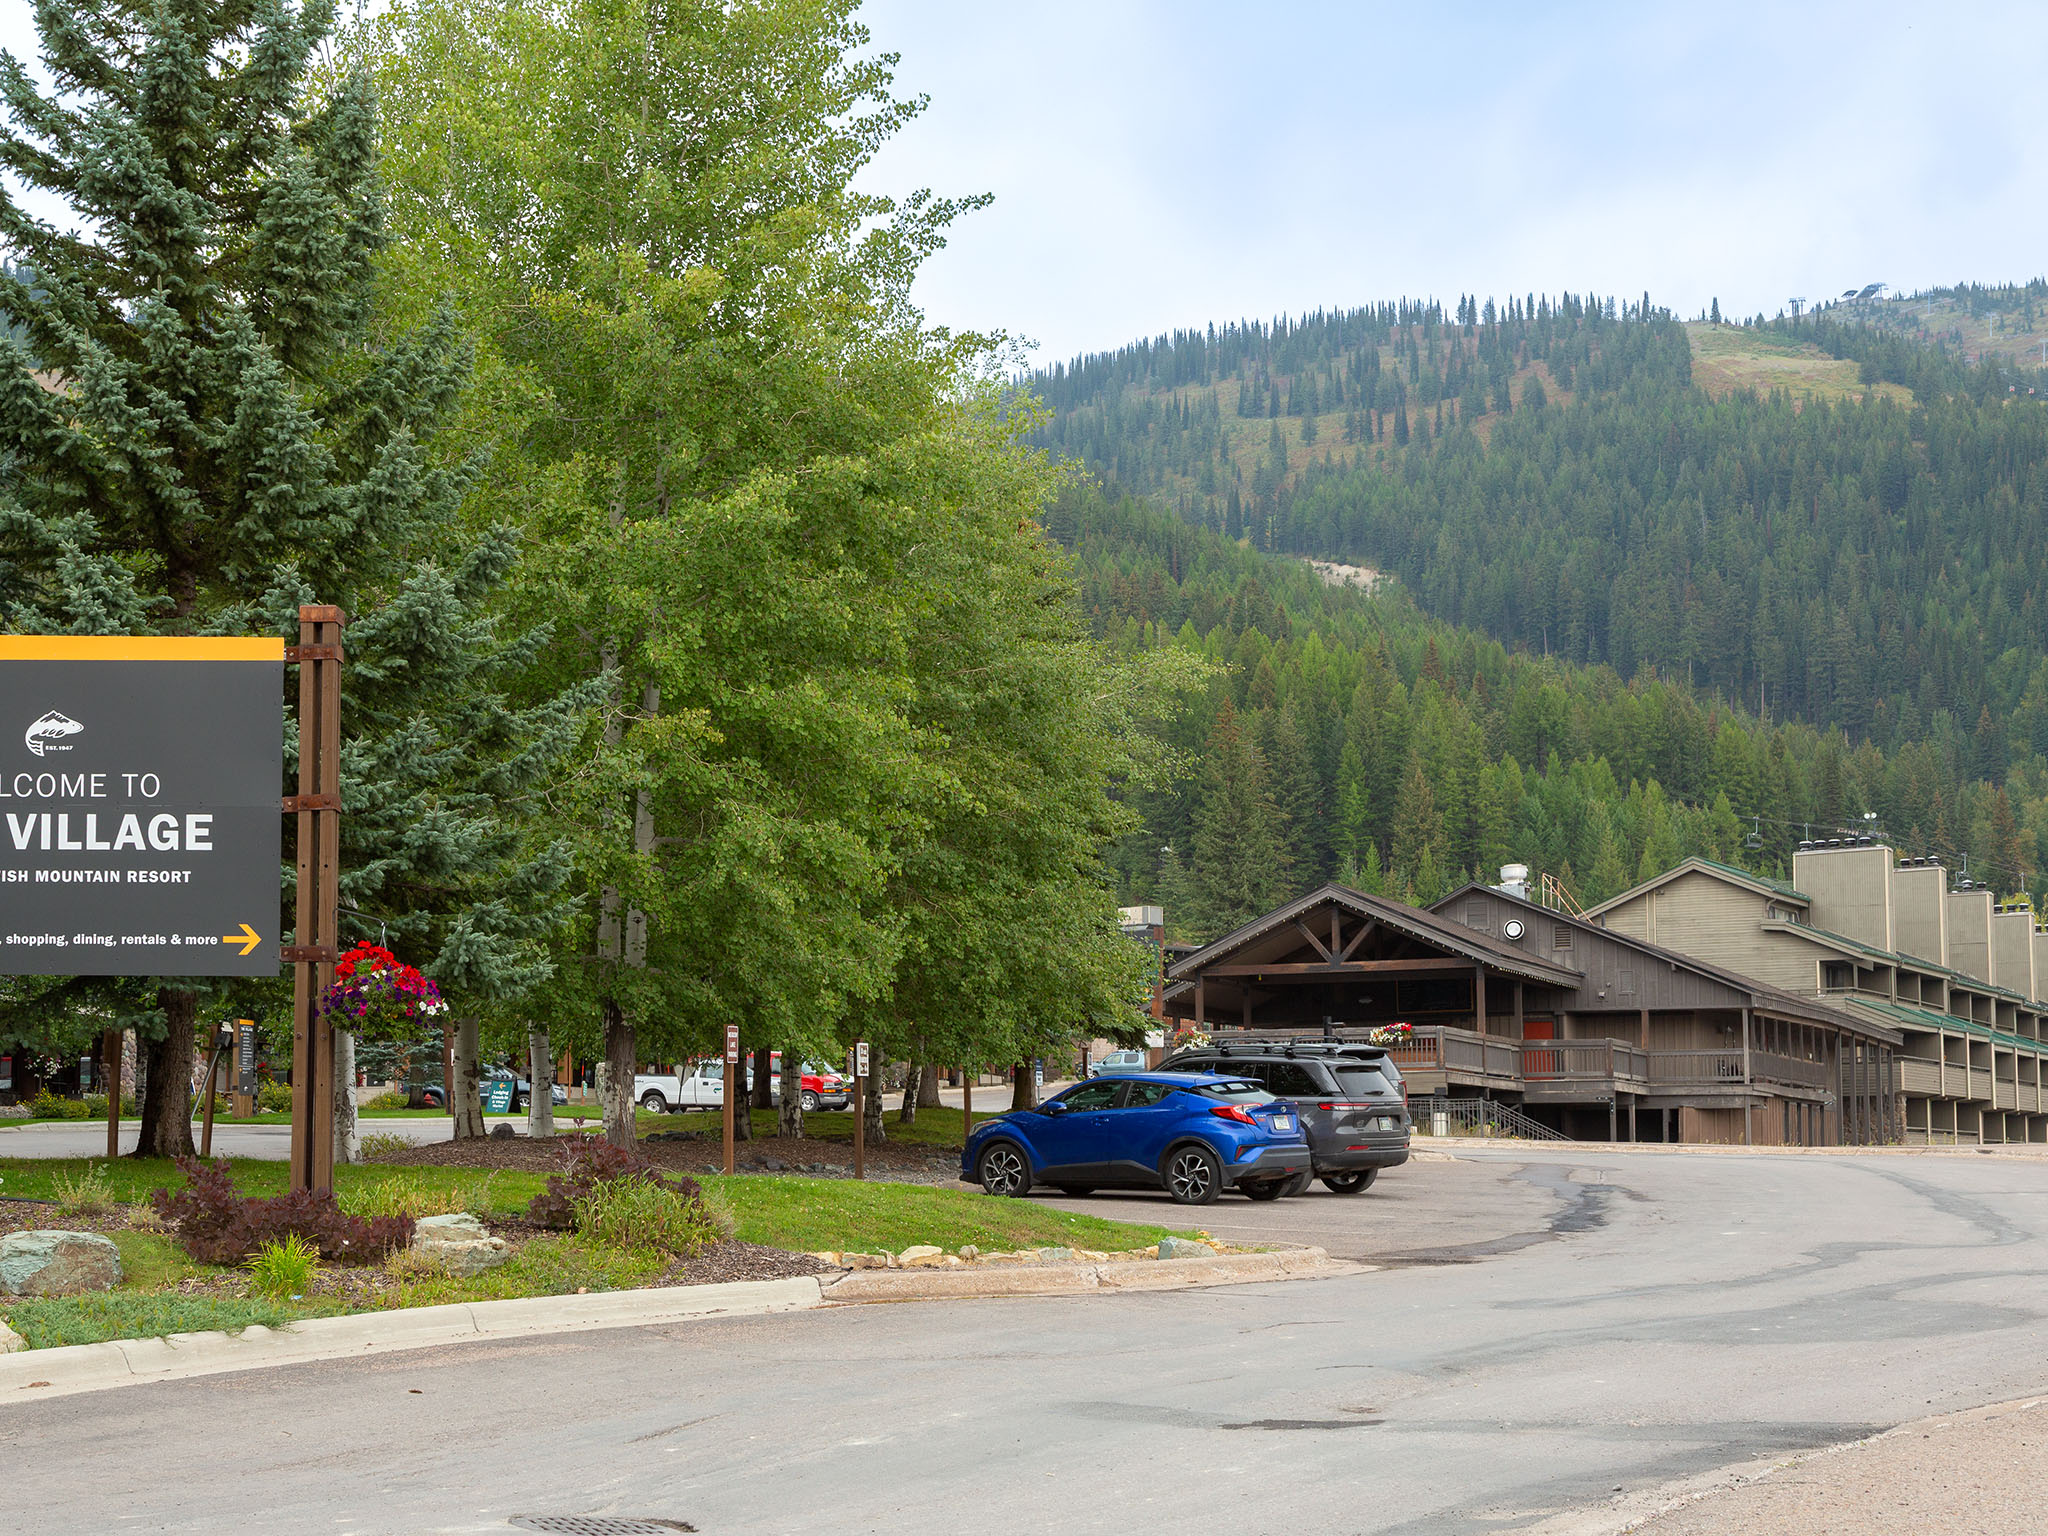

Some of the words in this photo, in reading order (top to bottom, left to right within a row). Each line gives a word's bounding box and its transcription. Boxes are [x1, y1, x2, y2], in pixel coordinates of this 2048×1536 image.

[122, 773, 160, 798] TO
[6, 813, 213, 851] VILLAGE
[0, 869, 28, 883] ISH
[35, 869, 120, 883] MOUNTAIN
[127, 870, 191, 883] RESORT
[6, 933, 68, 947] shopping,
[73, 933, 117, 947] dining,
[121, 933, 166, 945] rentals
[171, 934, 181, 945] &
[185, 936, 217, 946] more
